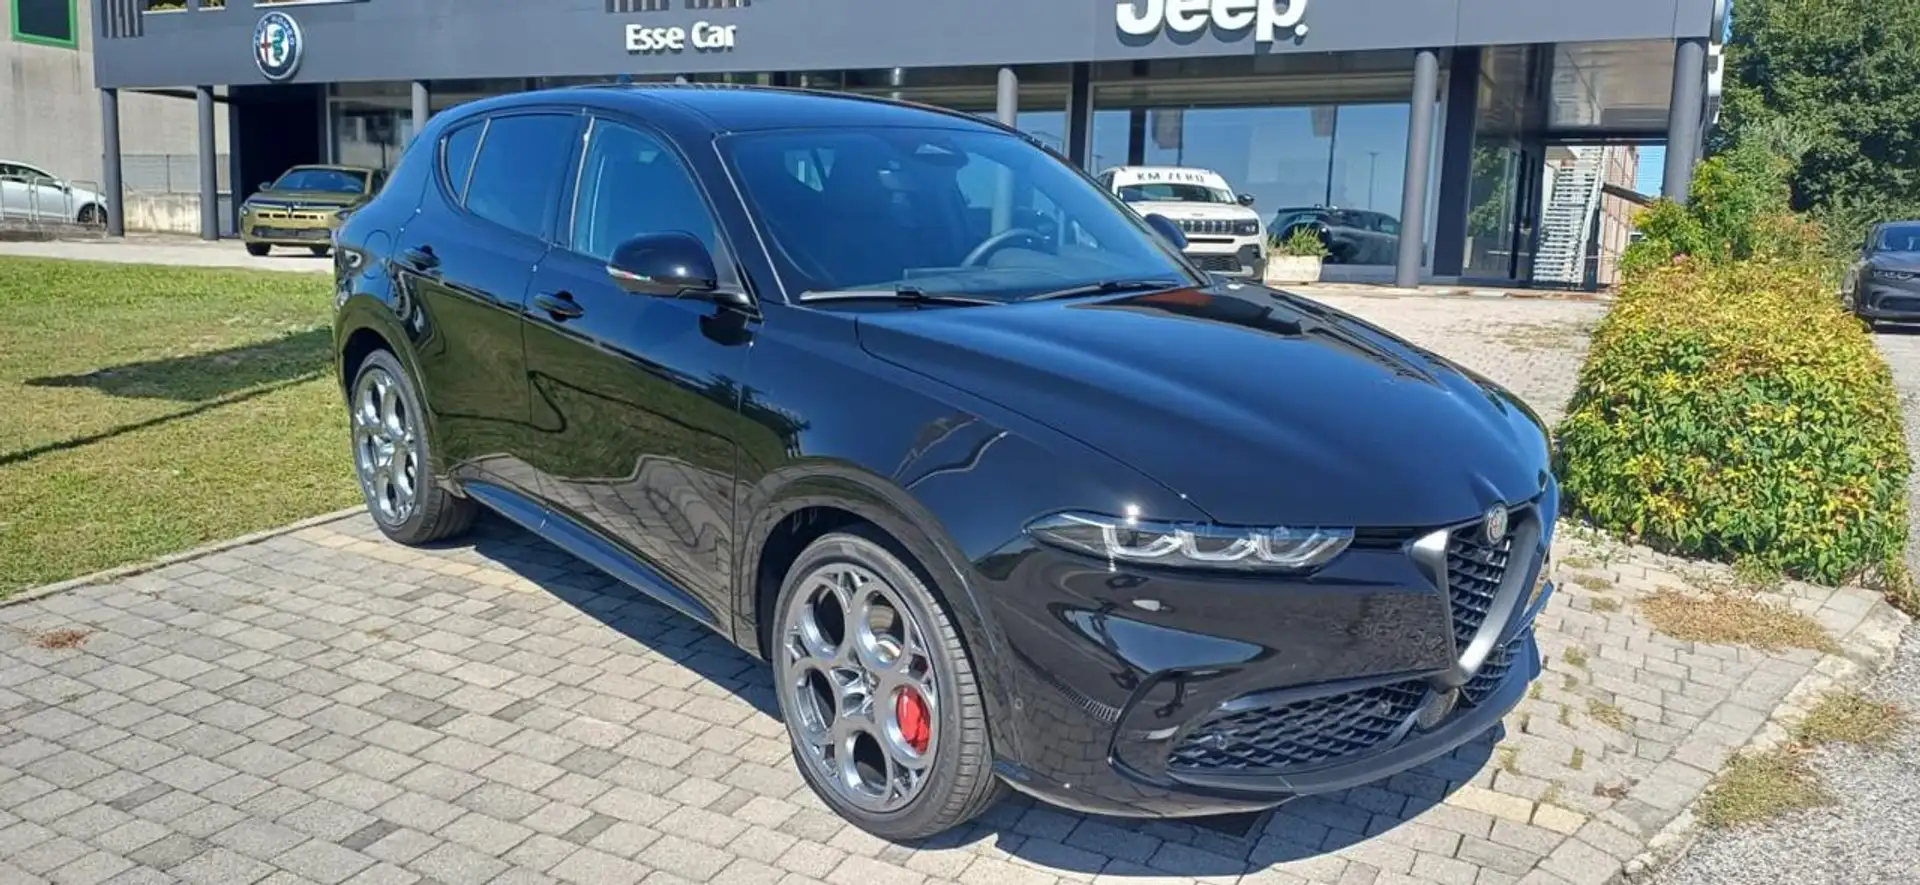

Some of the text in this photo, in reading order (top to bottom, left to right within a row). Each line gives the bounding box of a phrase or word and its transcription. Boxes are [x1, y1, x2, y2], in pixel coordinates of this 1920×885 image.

[625, 20, 737, 50] Esse Car
[1136, 171, 1161, 181] KM
